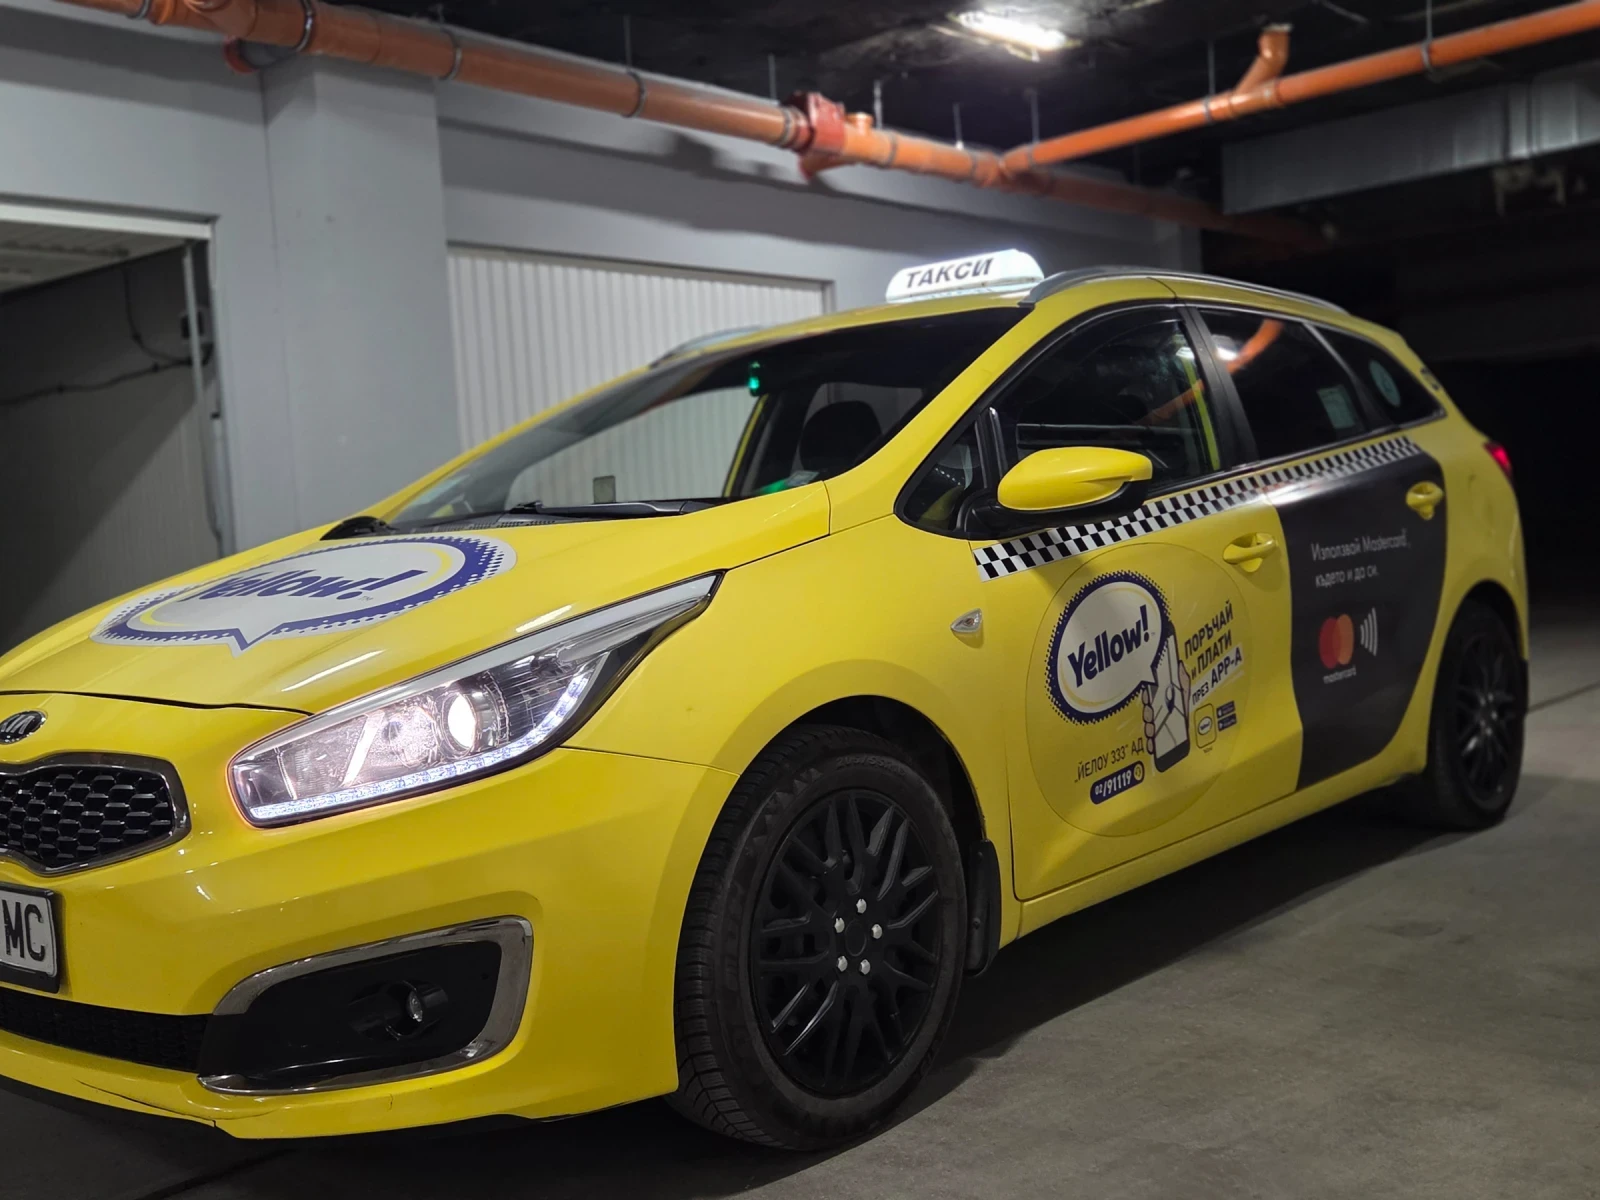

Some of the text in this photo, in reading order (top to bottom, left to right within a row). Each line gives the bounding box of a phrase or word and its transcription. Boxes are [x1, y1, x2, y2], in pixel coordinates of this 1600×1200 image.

[906, 257, 994, 288] ТАКСИ
[178, 569, 428, 602] Yellow!
[1315, 571, 1345, 588] където
[1184, 599, 1234, 660] ПОРЪЧАЙ
[1067, 604, 1149, 688] Yellow!
[1197, 629, 1232, 674] ПЛАТИ
[1192, 682, 1209, 705] ПРЕЗ
[1131, 737, 1144, 756] АД
